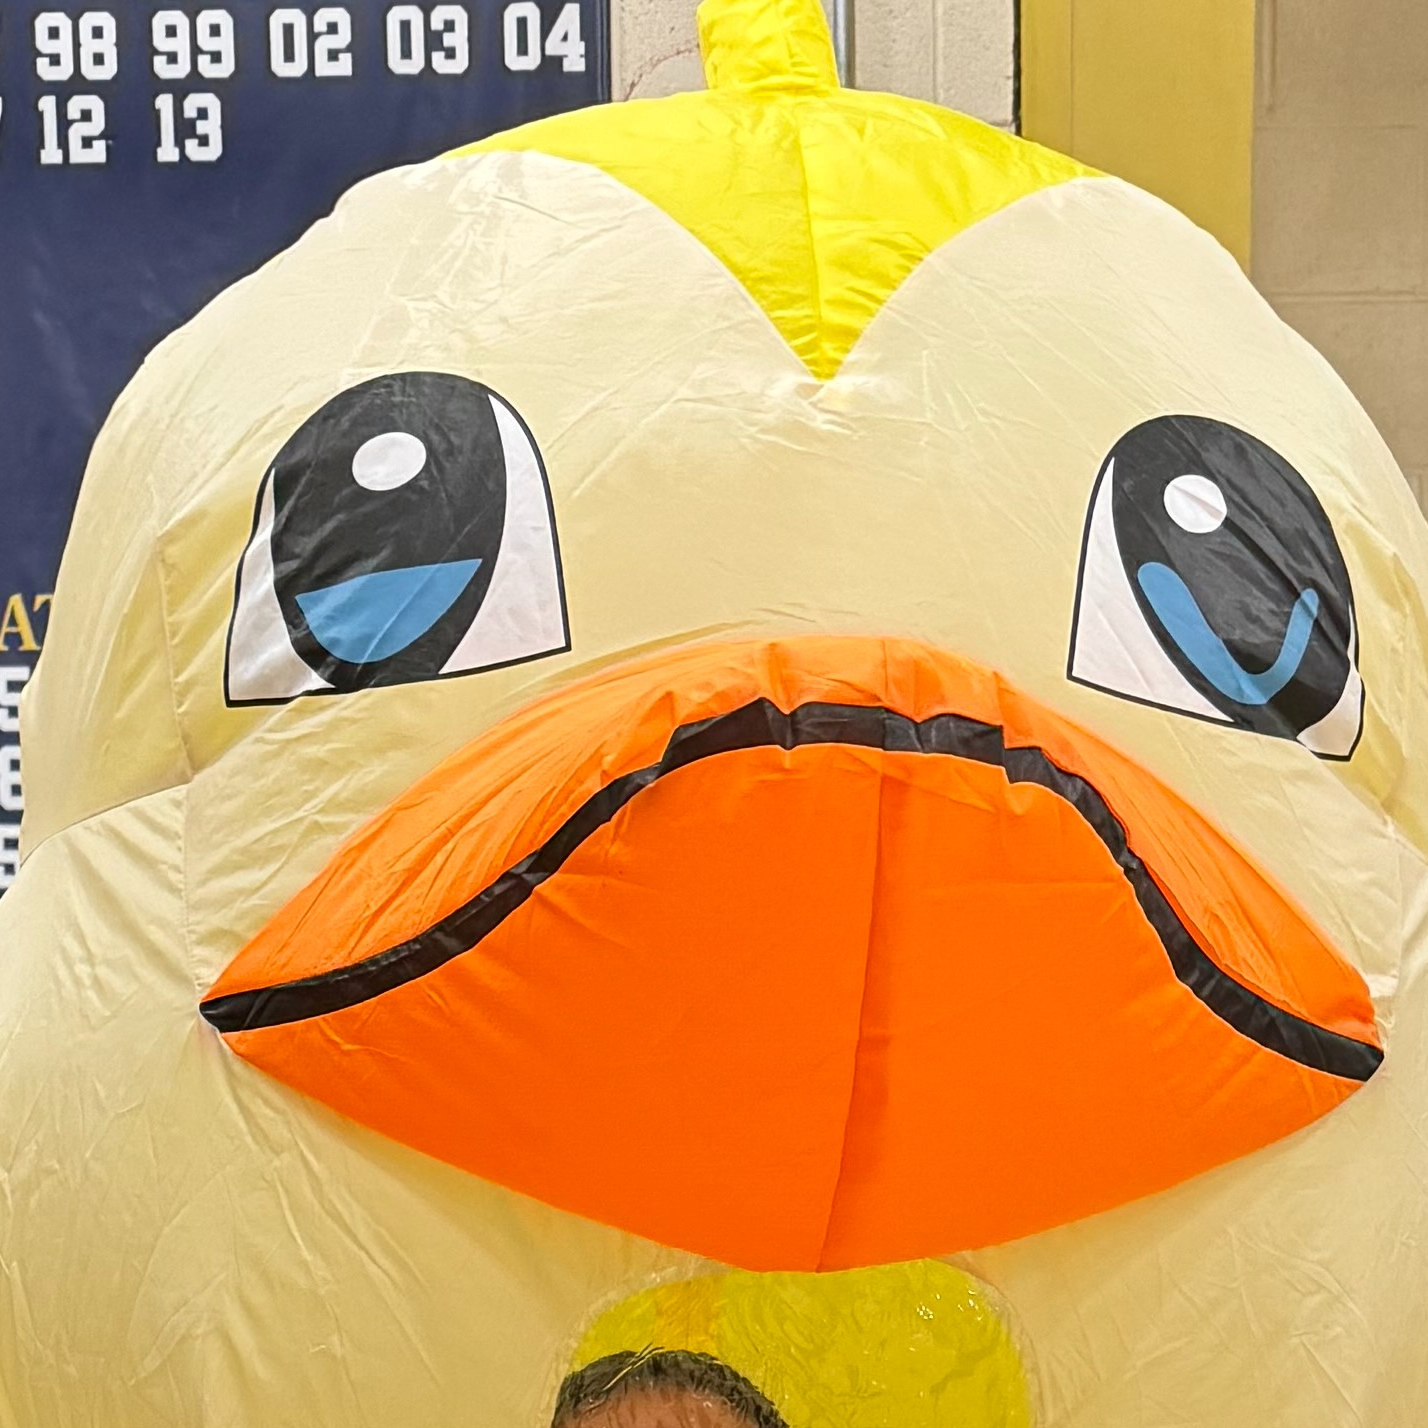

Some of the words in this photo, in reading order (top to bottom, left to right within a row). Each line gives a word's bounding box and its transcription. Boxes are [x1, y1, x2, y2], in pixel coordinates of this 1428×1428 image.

[34, 11, 117, 82] 98
[152, 9, 235, 79] 99
[269, 7, 352, 77] 02
[386, 4, 469, 75] 03
[502, 1, 585, 72] 04
[38, 95, 107, 164] 12
[155, 93, 222, 162] 13
